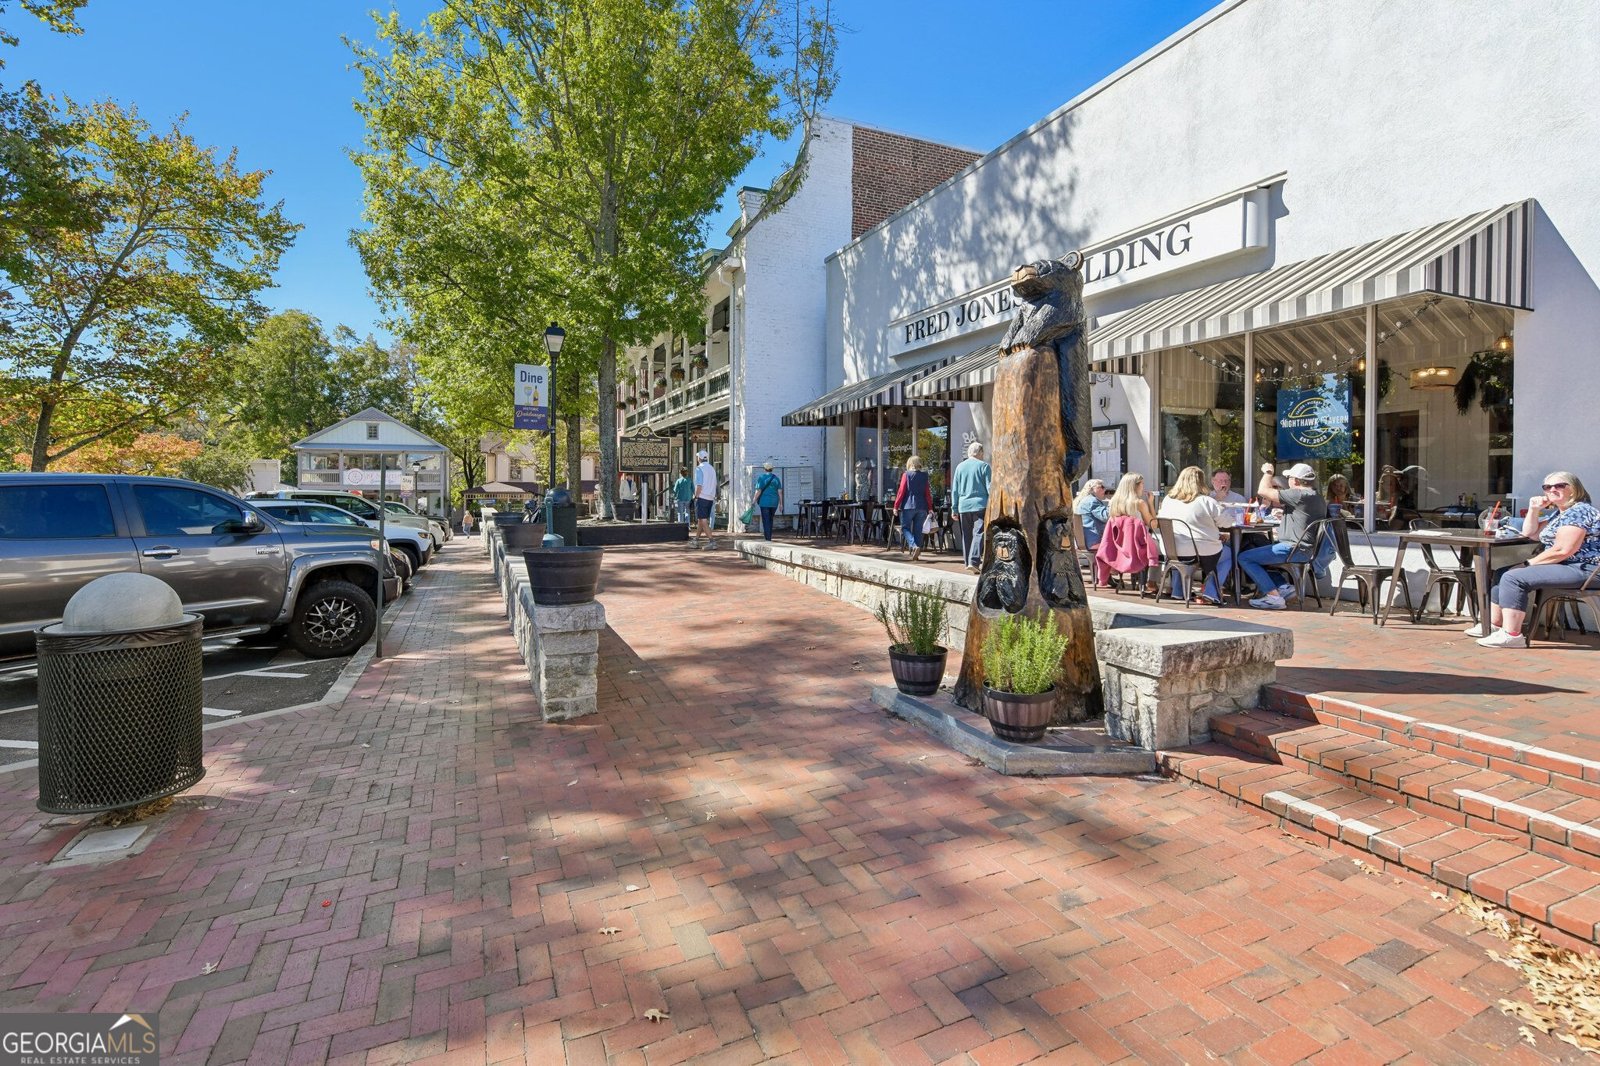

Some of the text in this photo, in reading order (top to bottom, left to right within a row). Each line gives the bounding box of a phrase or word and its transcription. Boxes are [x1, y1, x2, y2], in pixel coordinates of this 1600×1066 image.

[905, 311, 949, 344] FRED
[1084, 222, 1192, 284] LDING
[520, 370, 543, 384] Dine
[1280, 415, 1349, 428] NIGHTHAWK TAVERN
